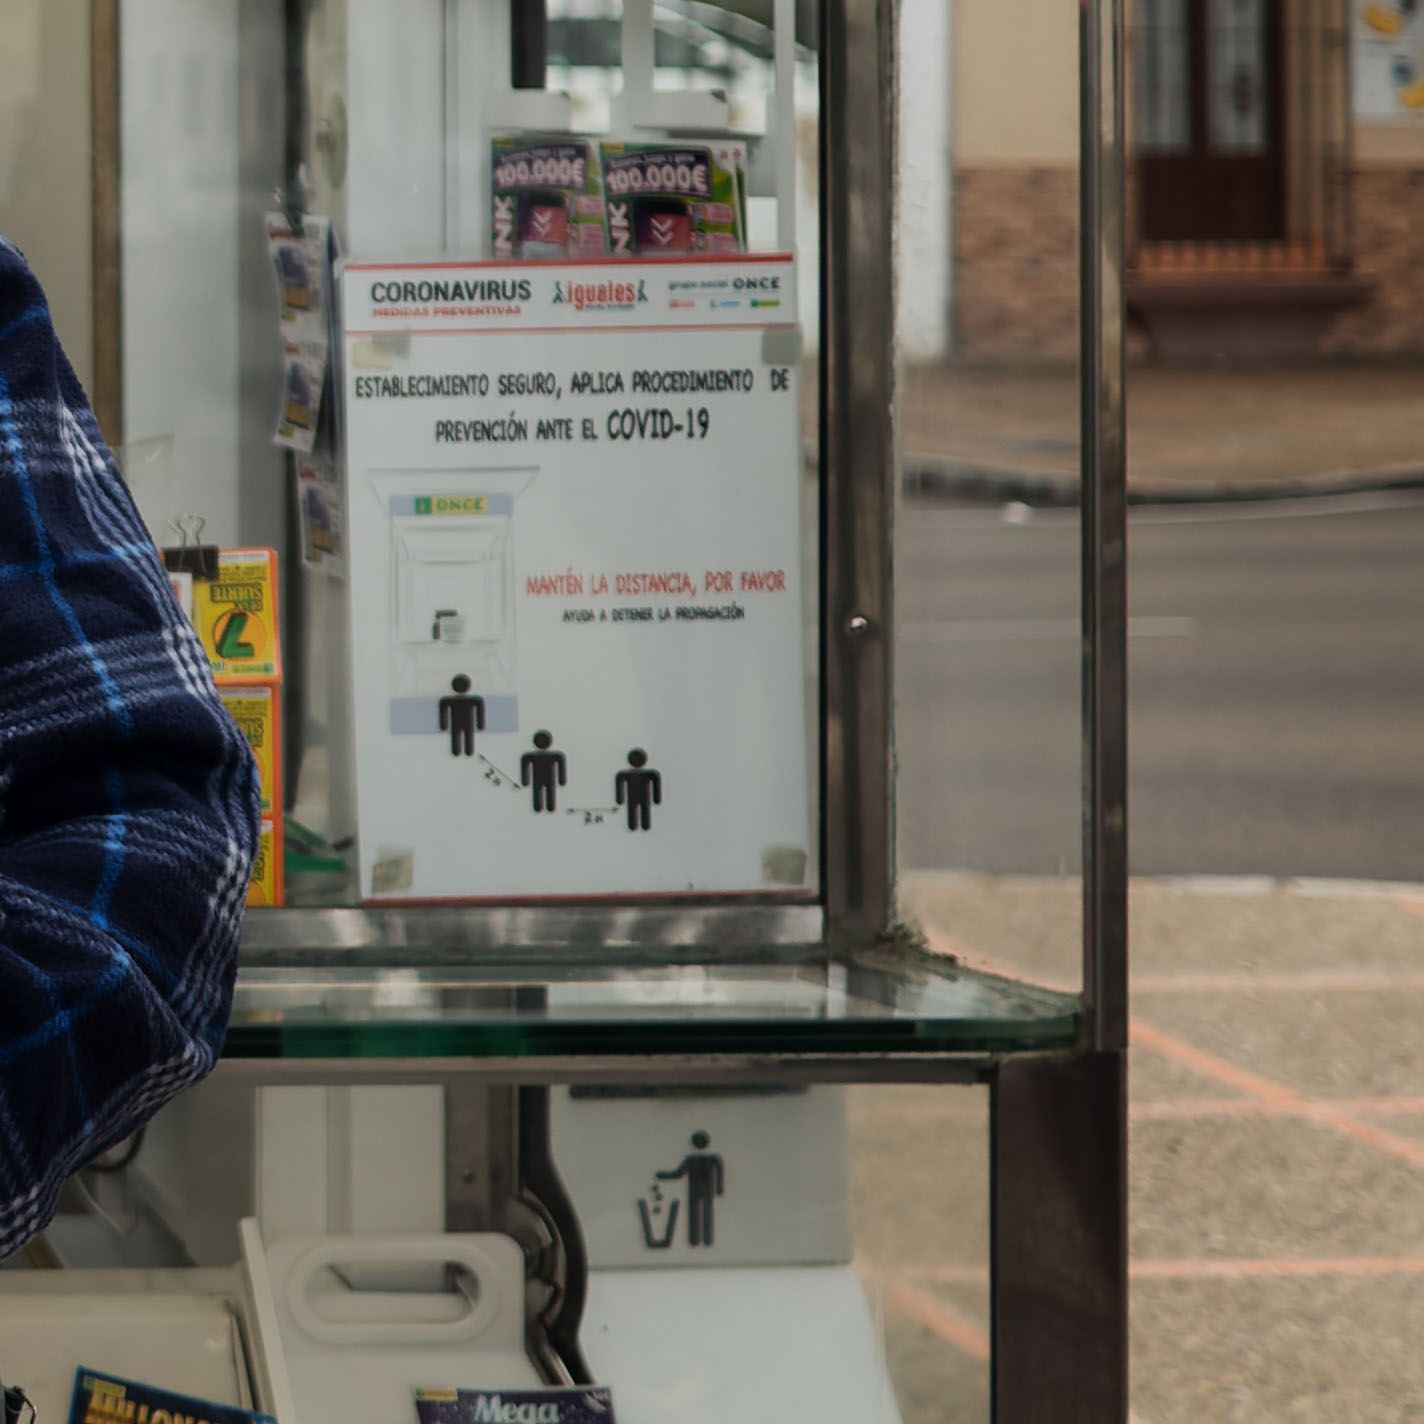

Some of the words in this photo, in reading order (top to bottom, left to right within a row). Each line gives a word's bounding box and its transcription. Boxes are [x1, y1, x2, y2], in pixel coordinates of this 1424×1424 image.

[494, 156, 584, 190] 100.000€
[606, 164, 708, 195] 100.000€
[371, 279, 532, 303] CORONAVIRUS
[567, 280, 637, 311] iguales
[732, 276, 781, 290] ONCE
[372, 306, 429, 318] MEDIDAS
[433, 304, 522, 317] PREVENTIVAS
[355, 374, 490, 398] ESTABLECIMIENTO
[498, 372, 562, 400] SEGURO,
[570, 371, 625, 394] APLICA
[632, 369, 754, 393] PROCEDIMIENTO
[770, 368, 790, 392] DE
[435, 411, 528, 442] PREVENCIÓN
[536, 418, 573, 440] ANTE
[582, 418, 598, 440] EL
[607, 407, 710, 440] COVID-19
[436, 496, 488, 512] ONCE
[210, 582, 264, 602] SUERTE
[526, 566, 584, 595] MANTÉN
[591, 574, 609, 594] LA
[615, 572, 697, 597] DISTANCIA,
[704, 570, 734, 592] POR
[740, 569, 787, 592] FAVOR
[562, 608, 595, 623] AYUDA
[599, 607, 607, 622] A
[611, 606, 654, 622] DETENER
[658, 606, 671, 621] LA
[675, 601, 745, 620] PROPAGACIÓN
[215, 612, 255, 659] 7
[474, 1394, 562, 1424] Mega
